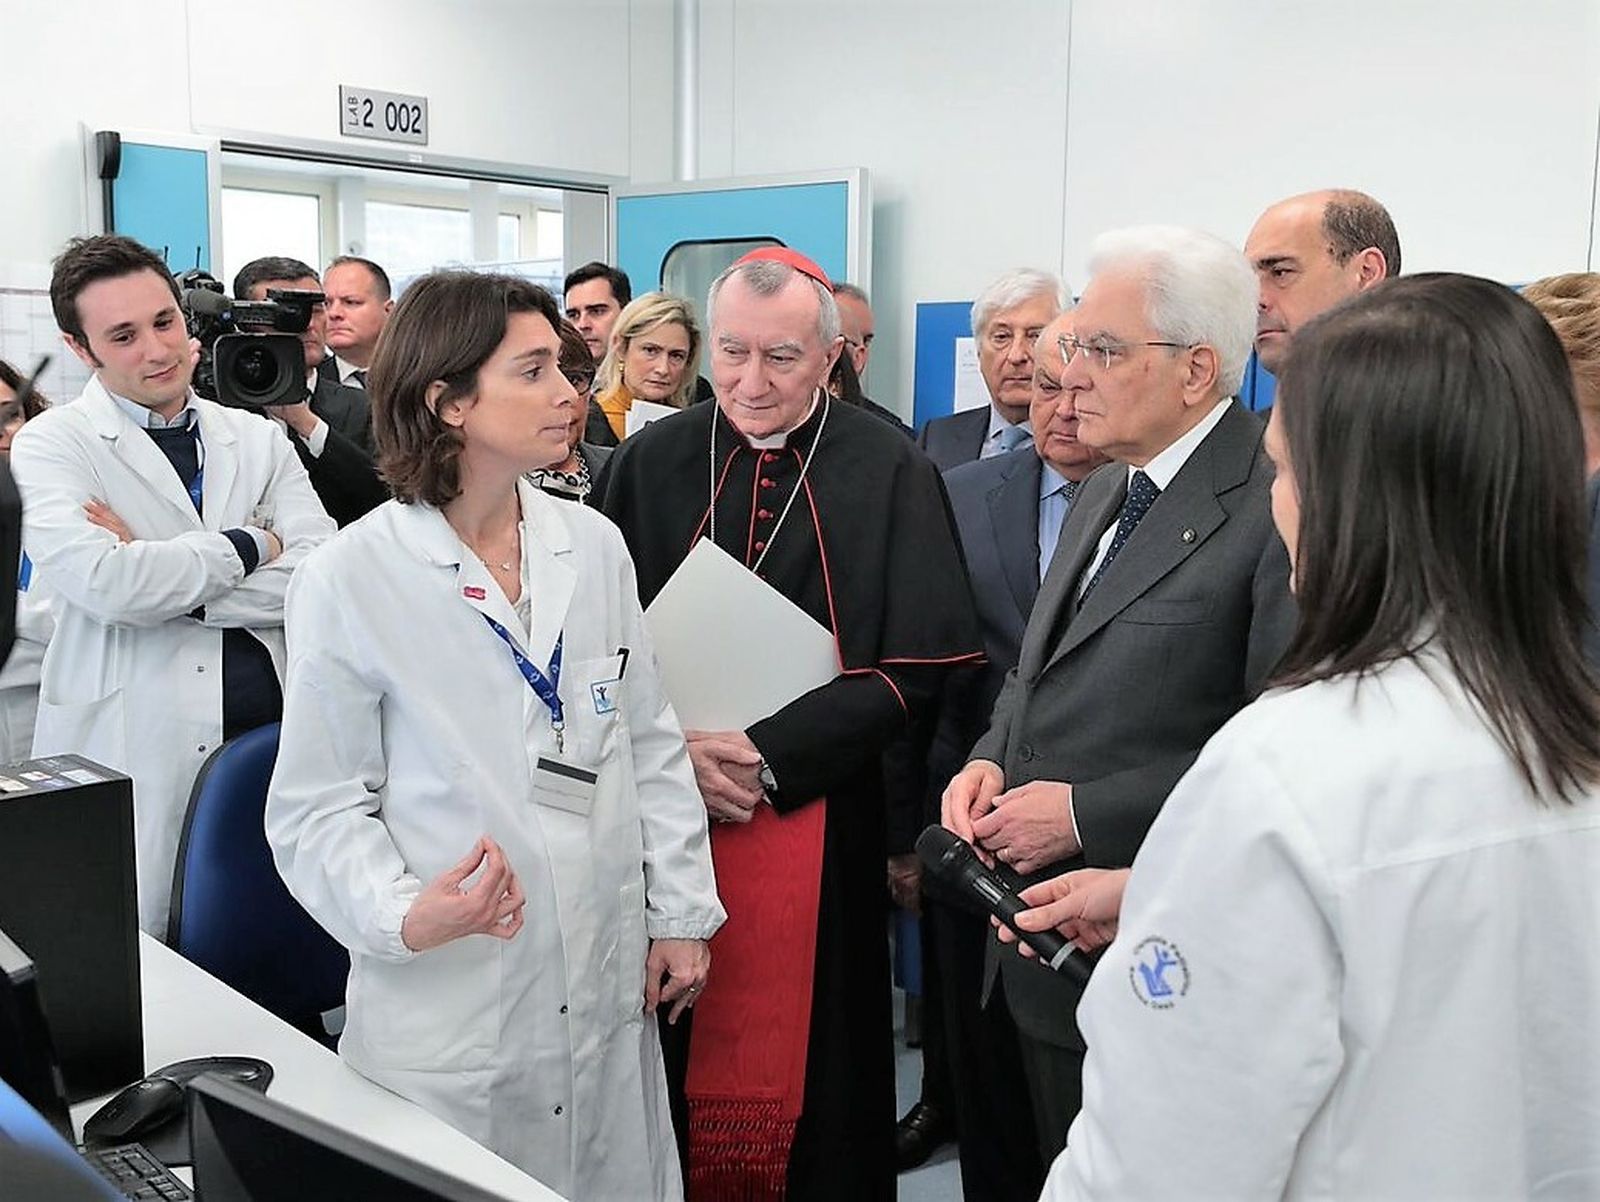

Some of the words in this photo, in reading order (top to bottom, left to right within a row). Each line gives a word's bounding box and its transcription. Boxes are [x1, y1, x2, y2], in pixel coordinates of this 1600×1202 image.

[348, 96, 359, 126] LAB
[363, 98, 374, 128] 2
[385, 101, 422, 134] 002
